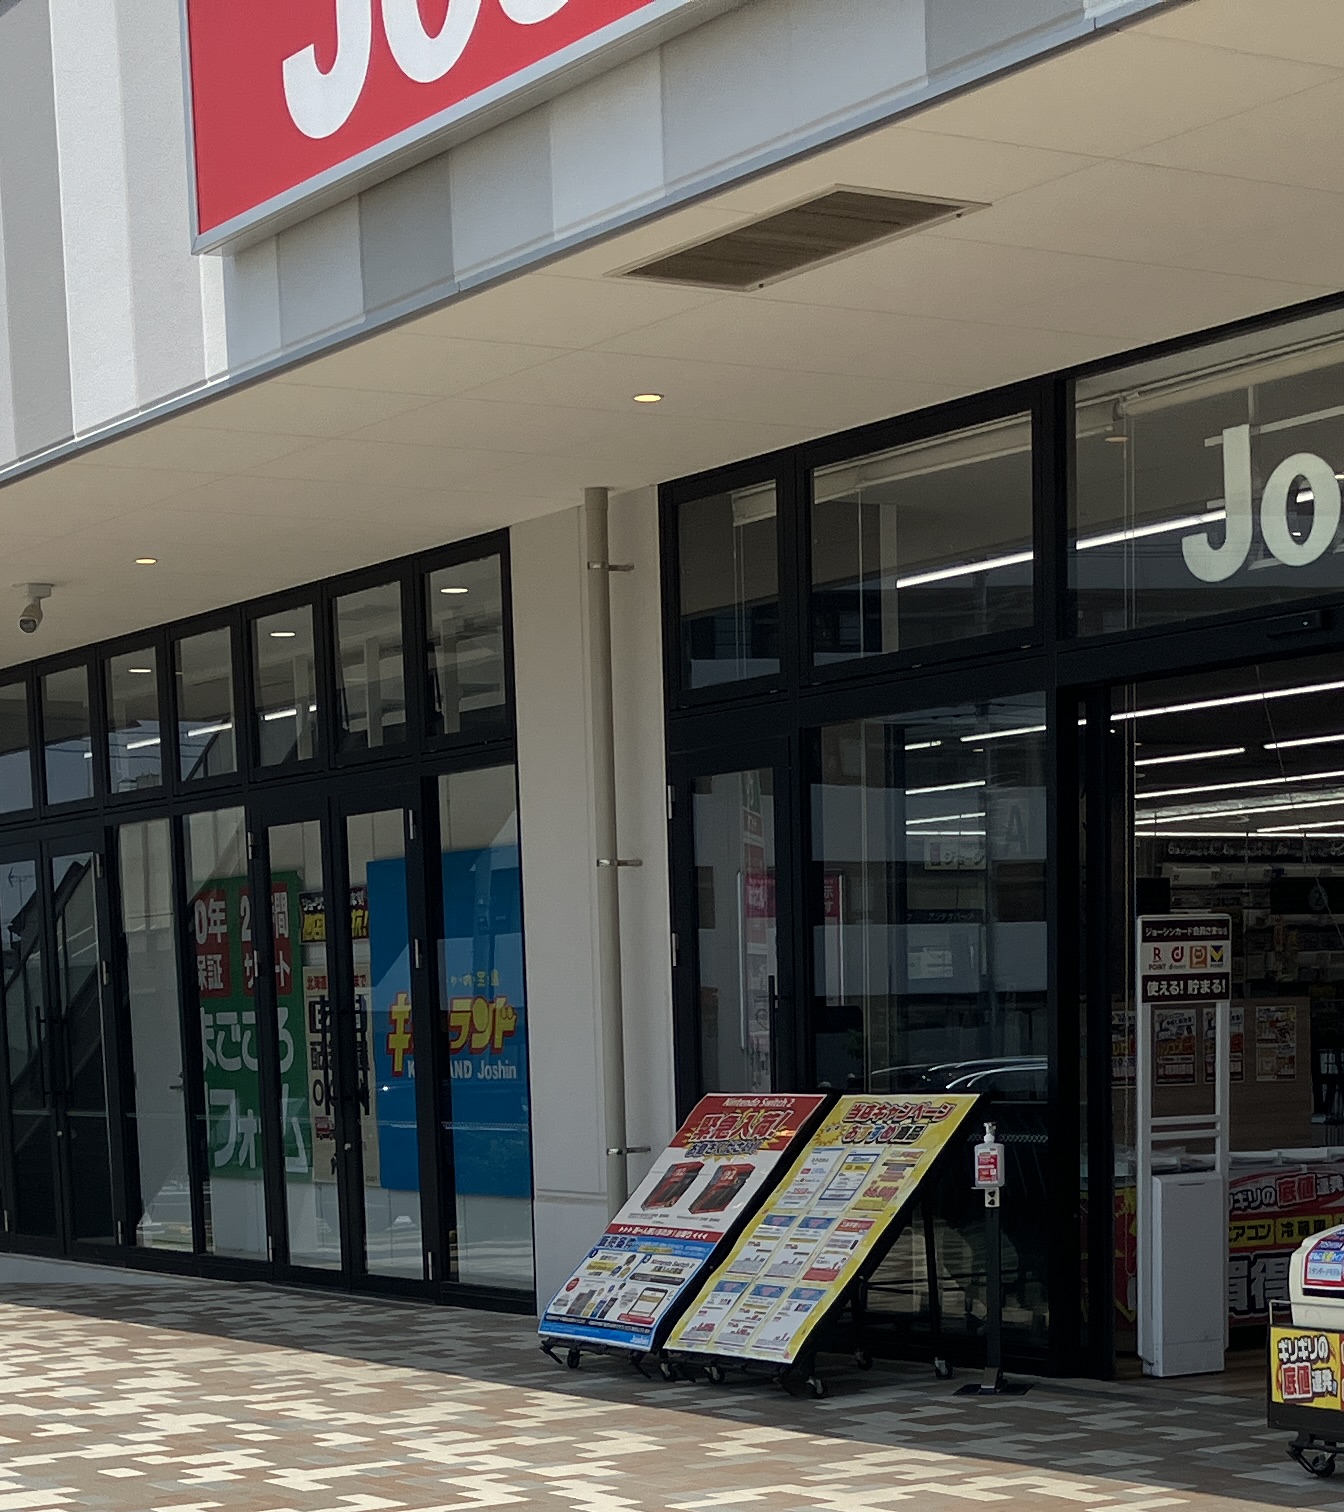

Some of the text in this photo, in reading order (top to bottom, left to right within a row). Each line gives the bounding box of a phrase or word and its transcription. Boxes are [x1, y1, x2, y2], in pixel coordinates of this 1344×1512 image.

[282, 0, 572, 139] Jo
[194, 897, 227, 945] 0年
[386, 992, 518, 1077] キランド
[476, 1059, 517, 1080] Joshin
[722, 1096, 760, 1108] Nintendo
[759, 1097, 789, 1108] Switch
[1278, 1335, 1329, 1362] ギリギリの
